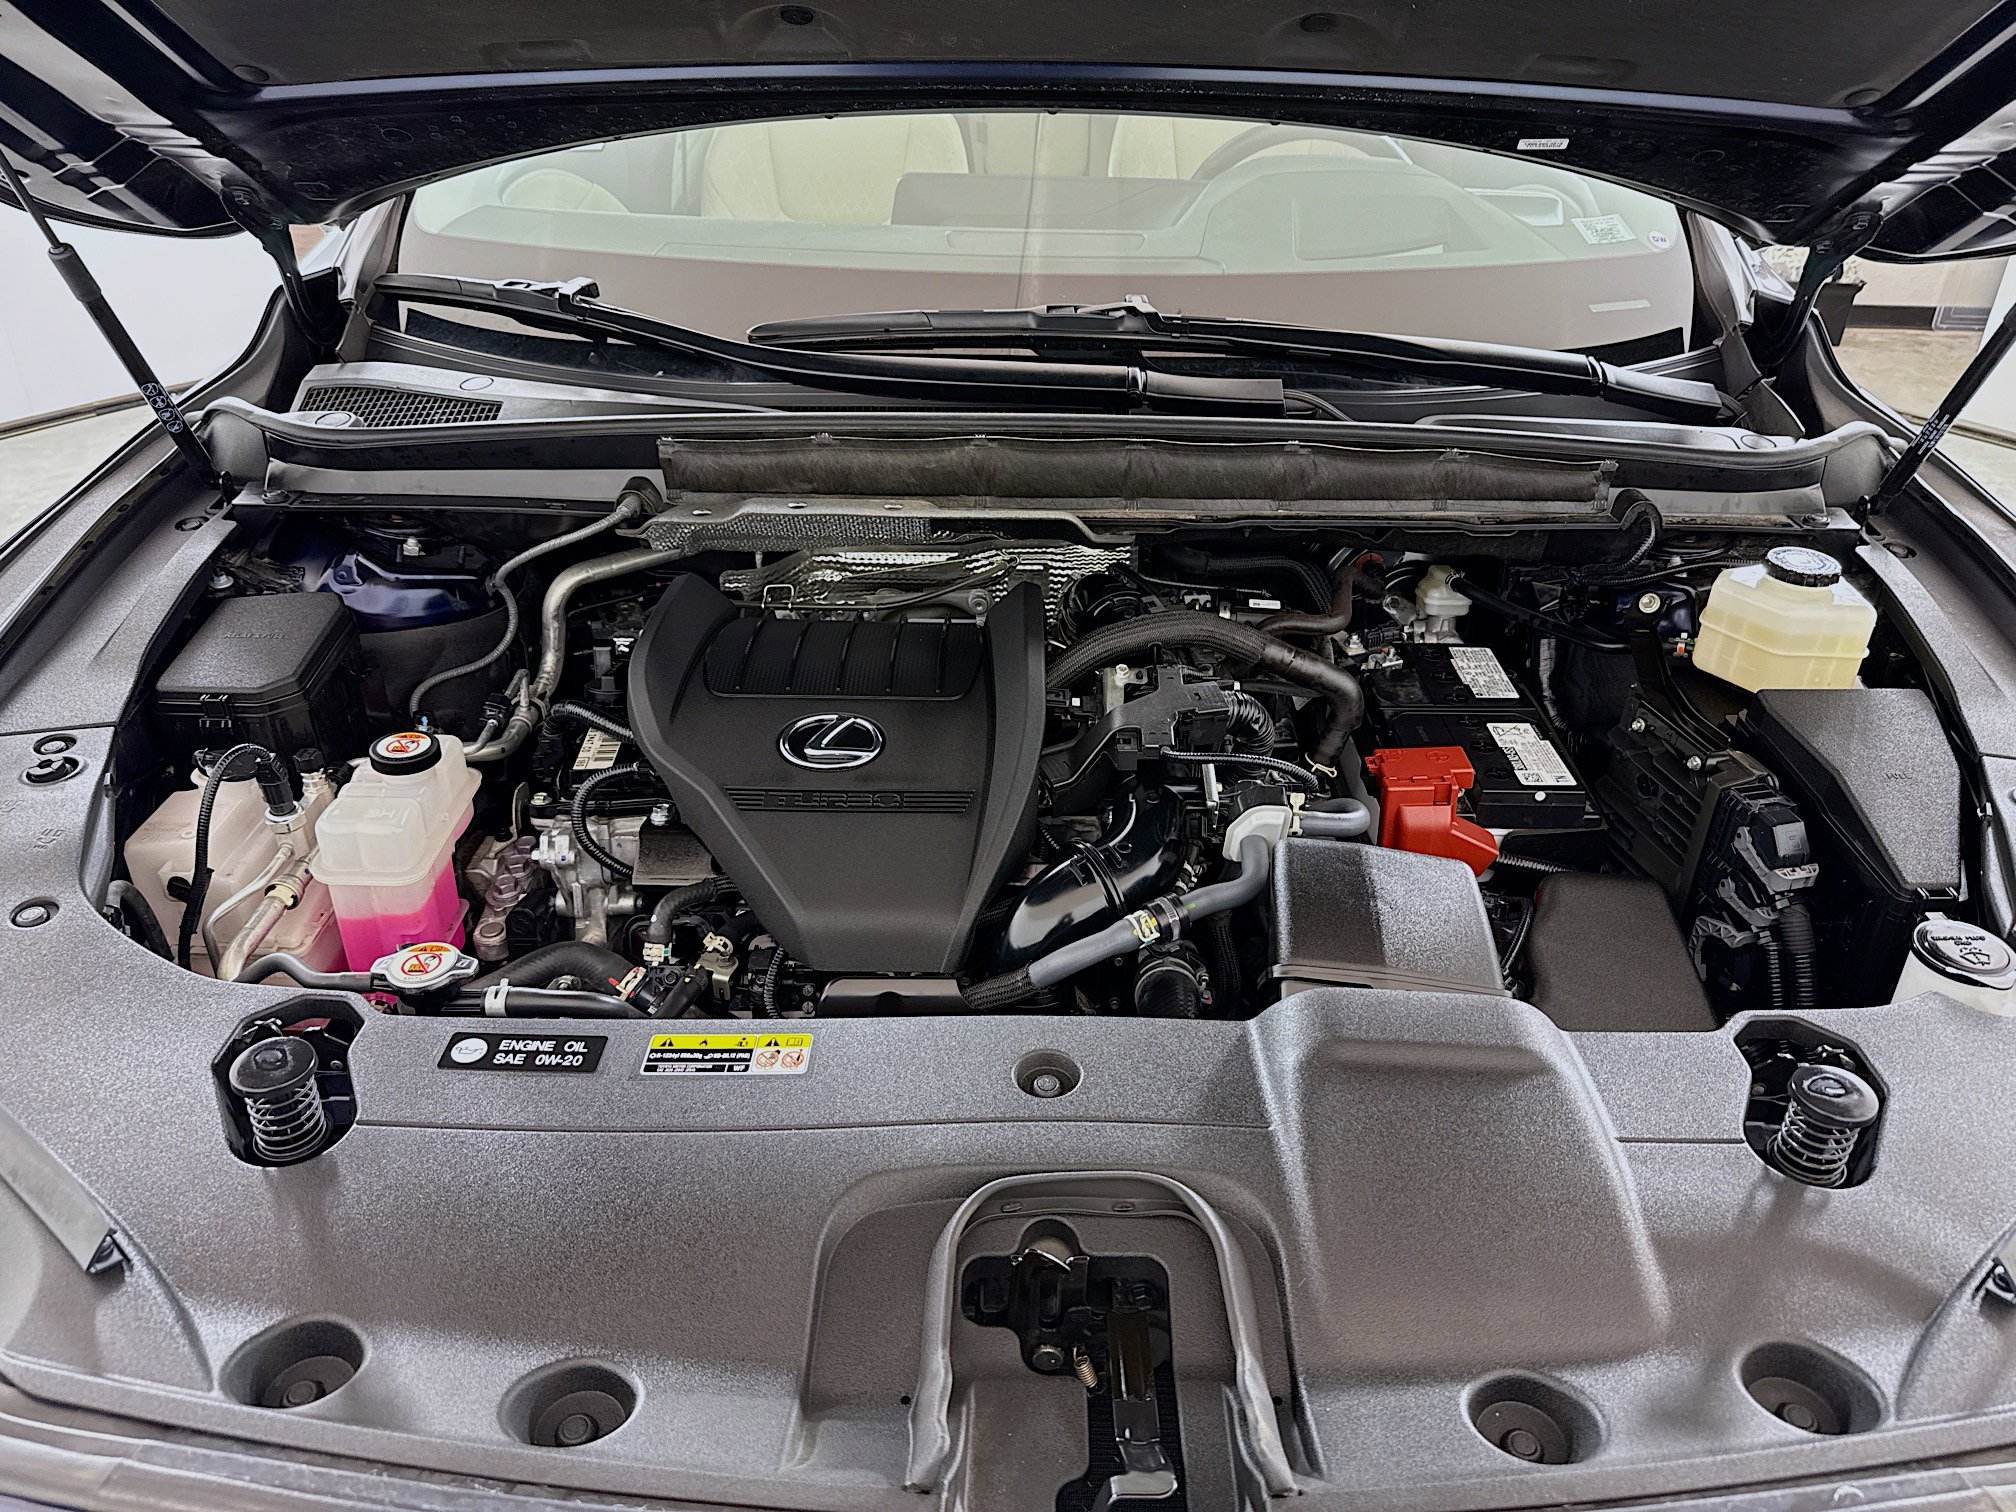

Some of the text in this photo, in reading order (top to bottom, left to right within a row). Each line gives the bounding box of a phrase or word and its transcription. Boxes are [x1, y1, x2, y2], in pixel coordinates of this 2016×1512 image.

[767, 791, 901, 808] TURBO
[498, 1039, 589, 1053] ENGINE OIL
[492, 1053, 584, 1067] SAE 0W-20
